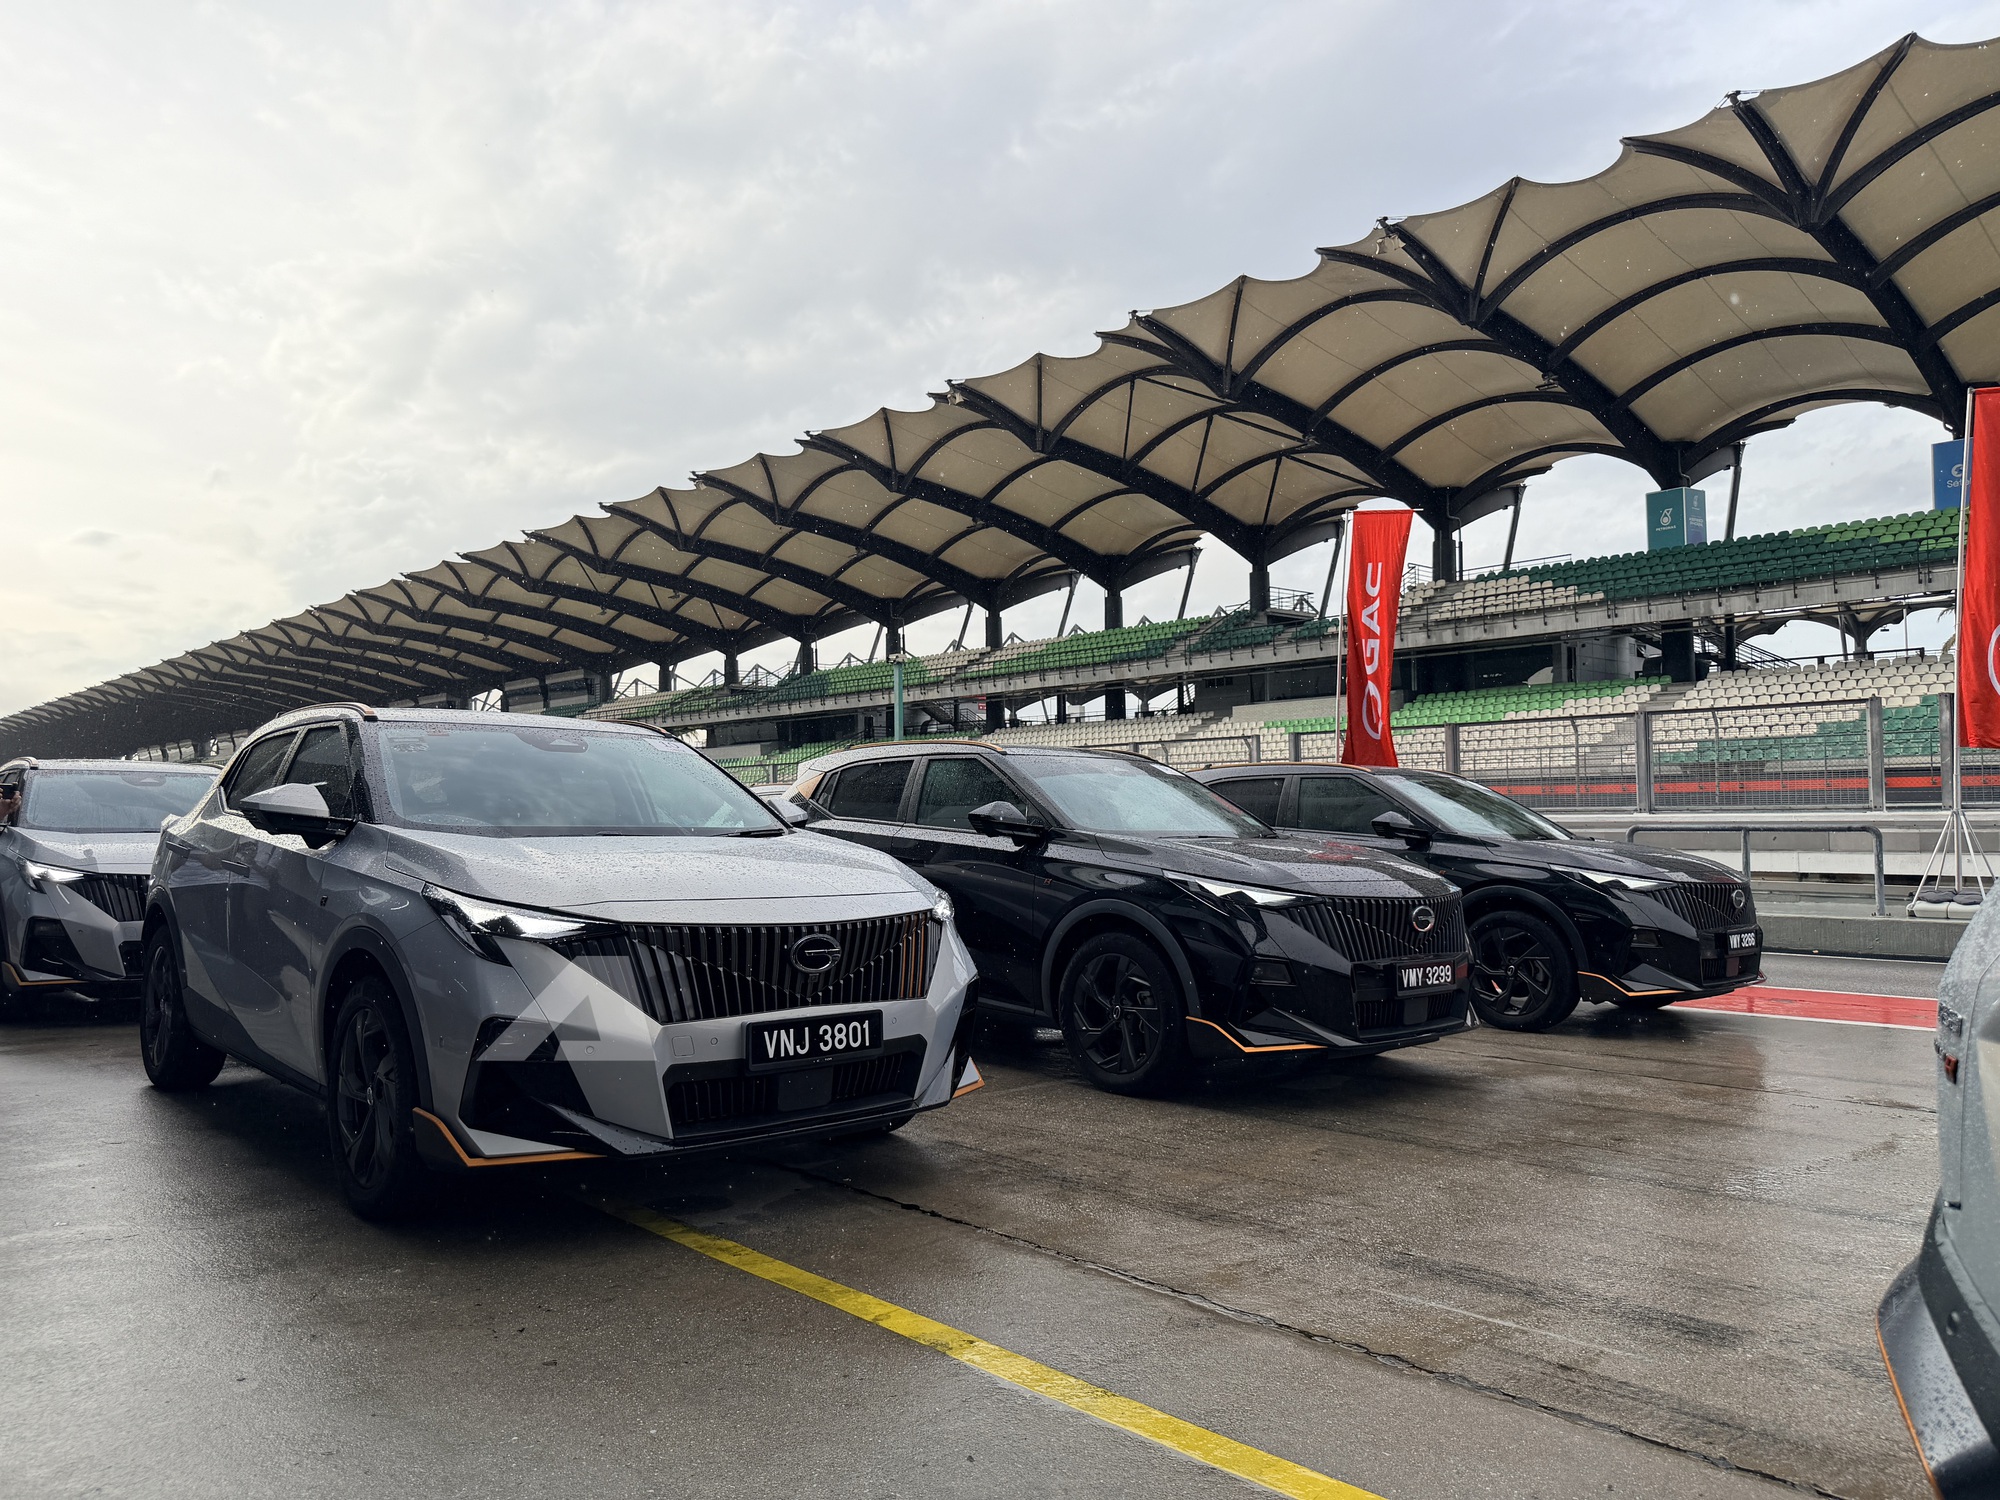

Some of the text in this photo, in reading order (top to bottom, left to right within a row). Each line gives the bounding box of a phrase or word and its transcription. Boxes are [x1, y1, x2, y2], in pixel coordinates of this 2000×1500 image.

[1361, 562, 1383, 676] GAC
[1401, 964, 1452, 988] VMY 3299
[763, 1020, 870, 1059] VNJ 3801
